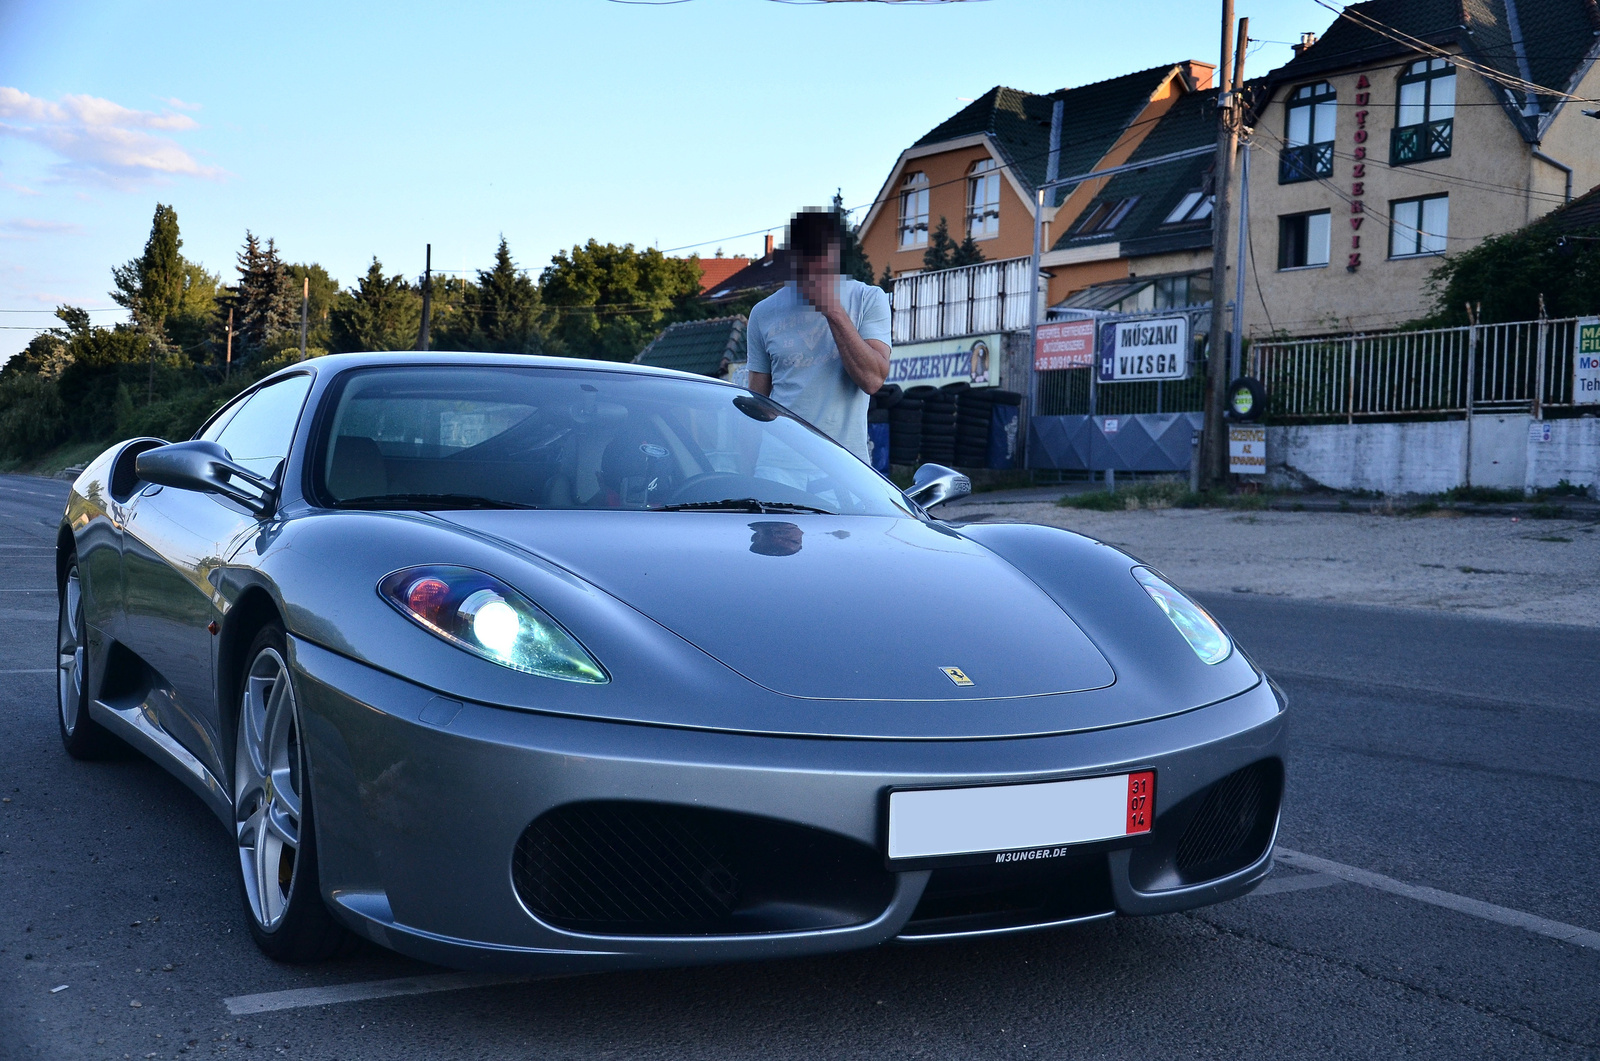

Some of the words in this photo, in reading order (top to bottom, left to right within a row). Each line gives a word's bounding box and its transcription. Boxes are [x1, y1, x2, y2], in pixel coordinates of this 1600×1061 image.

[1349, 74, 1371, 267] AUTÓSZERVIZ
[1121, 324, 1178, 347] MŰSZAKI
[1102, 357, 1112, 374] H
[1120, 354, 1177, 375] VIZSGA
[1580, 357, 1600, 369] Mo
[1230, 430, 1265, 441] SZERVIZ
[1242, 444, 1252, 454] AZ
[1132, 779, 1146, 793] 31
[1131, 796, 1146, 810] 07
[1131, 812, 1145, 827] 14
[995, 848, 1067, 863] M3UNGER.DE
